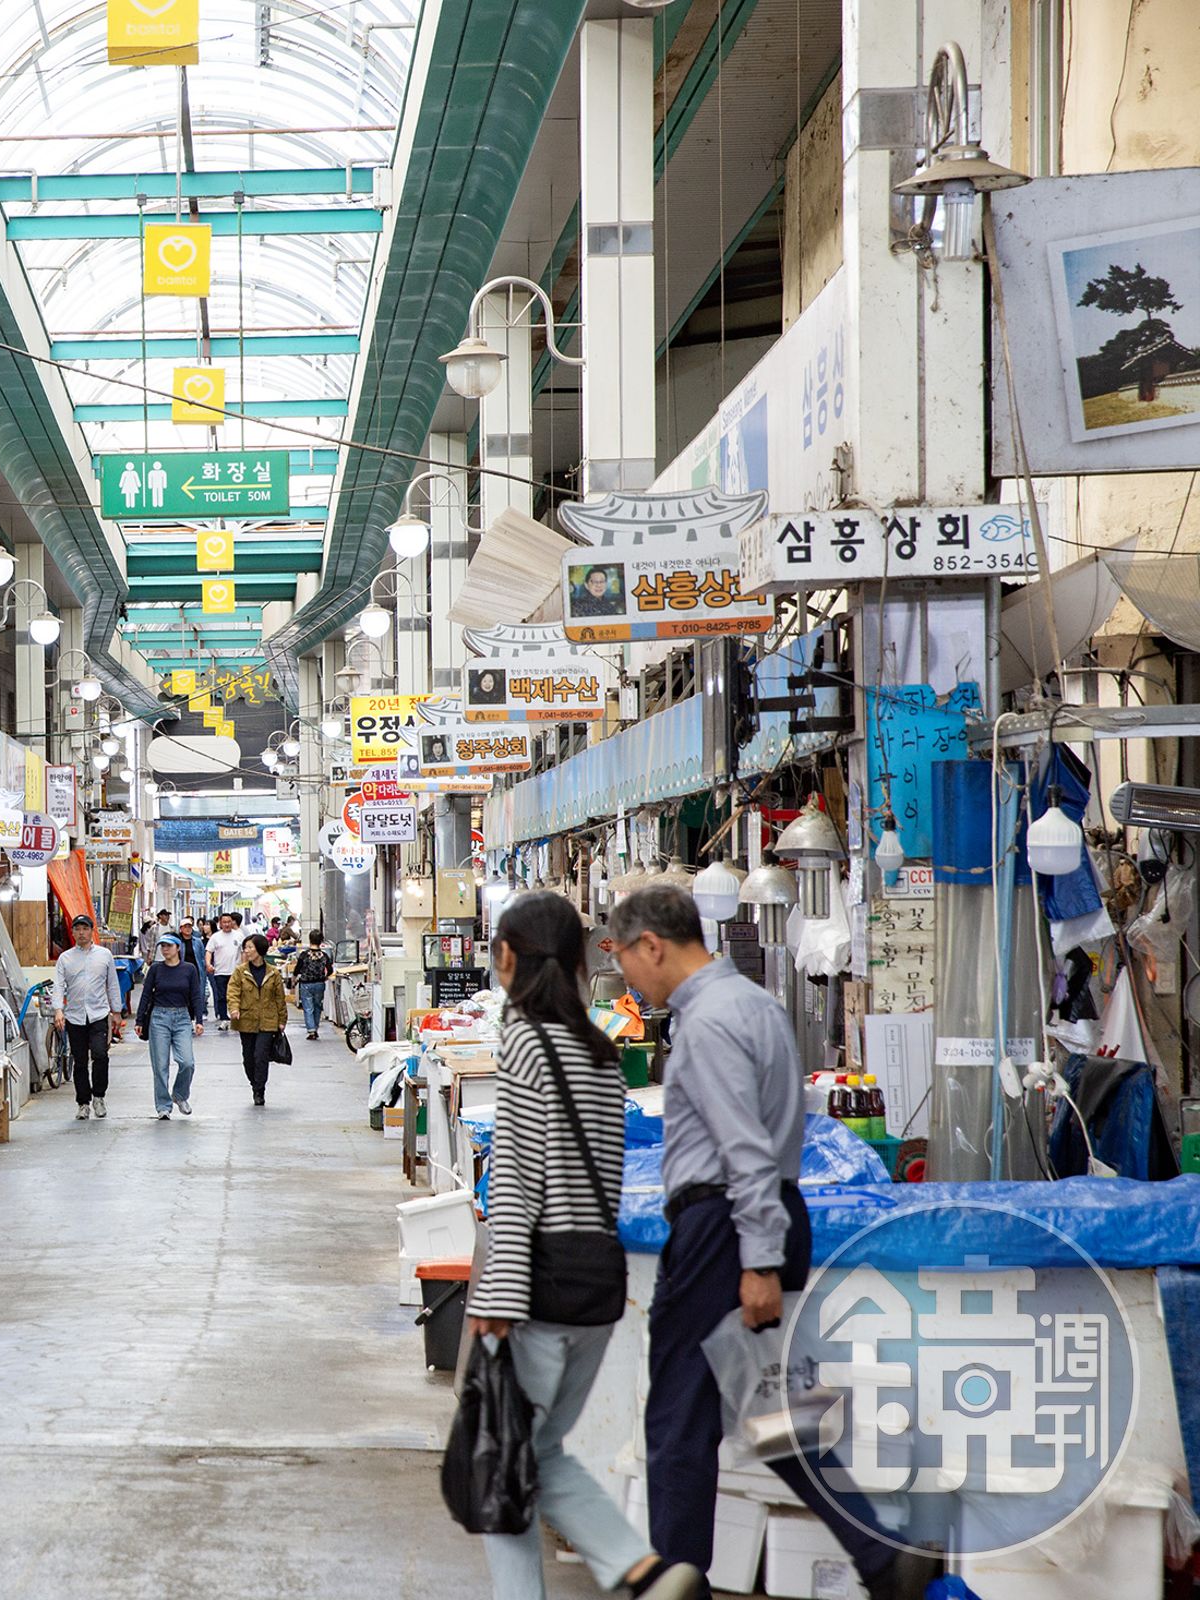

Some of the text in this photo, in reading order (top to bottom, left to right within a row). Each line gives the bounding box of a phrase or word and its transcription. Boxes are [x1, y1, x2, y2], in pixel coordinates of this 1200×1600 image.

[201, 461, 271, 482] 화장실
[204, 490, 271, 502] TOILET 50M
[777, 513, 970, 563] 삼흥상회
[509, 676, 599, 703] 백제수산
[369, 698, 400, 711] 20년
[456, 736, 527, 760] 청주상회
[364, 813, 412, 828] 달달도넛
[23, 826, 53, 849] 어물
[12, 850, 45, 861] 852-4962
[342, 857, 365, 869] 식당
[910, 869, 933, 884] CCT
